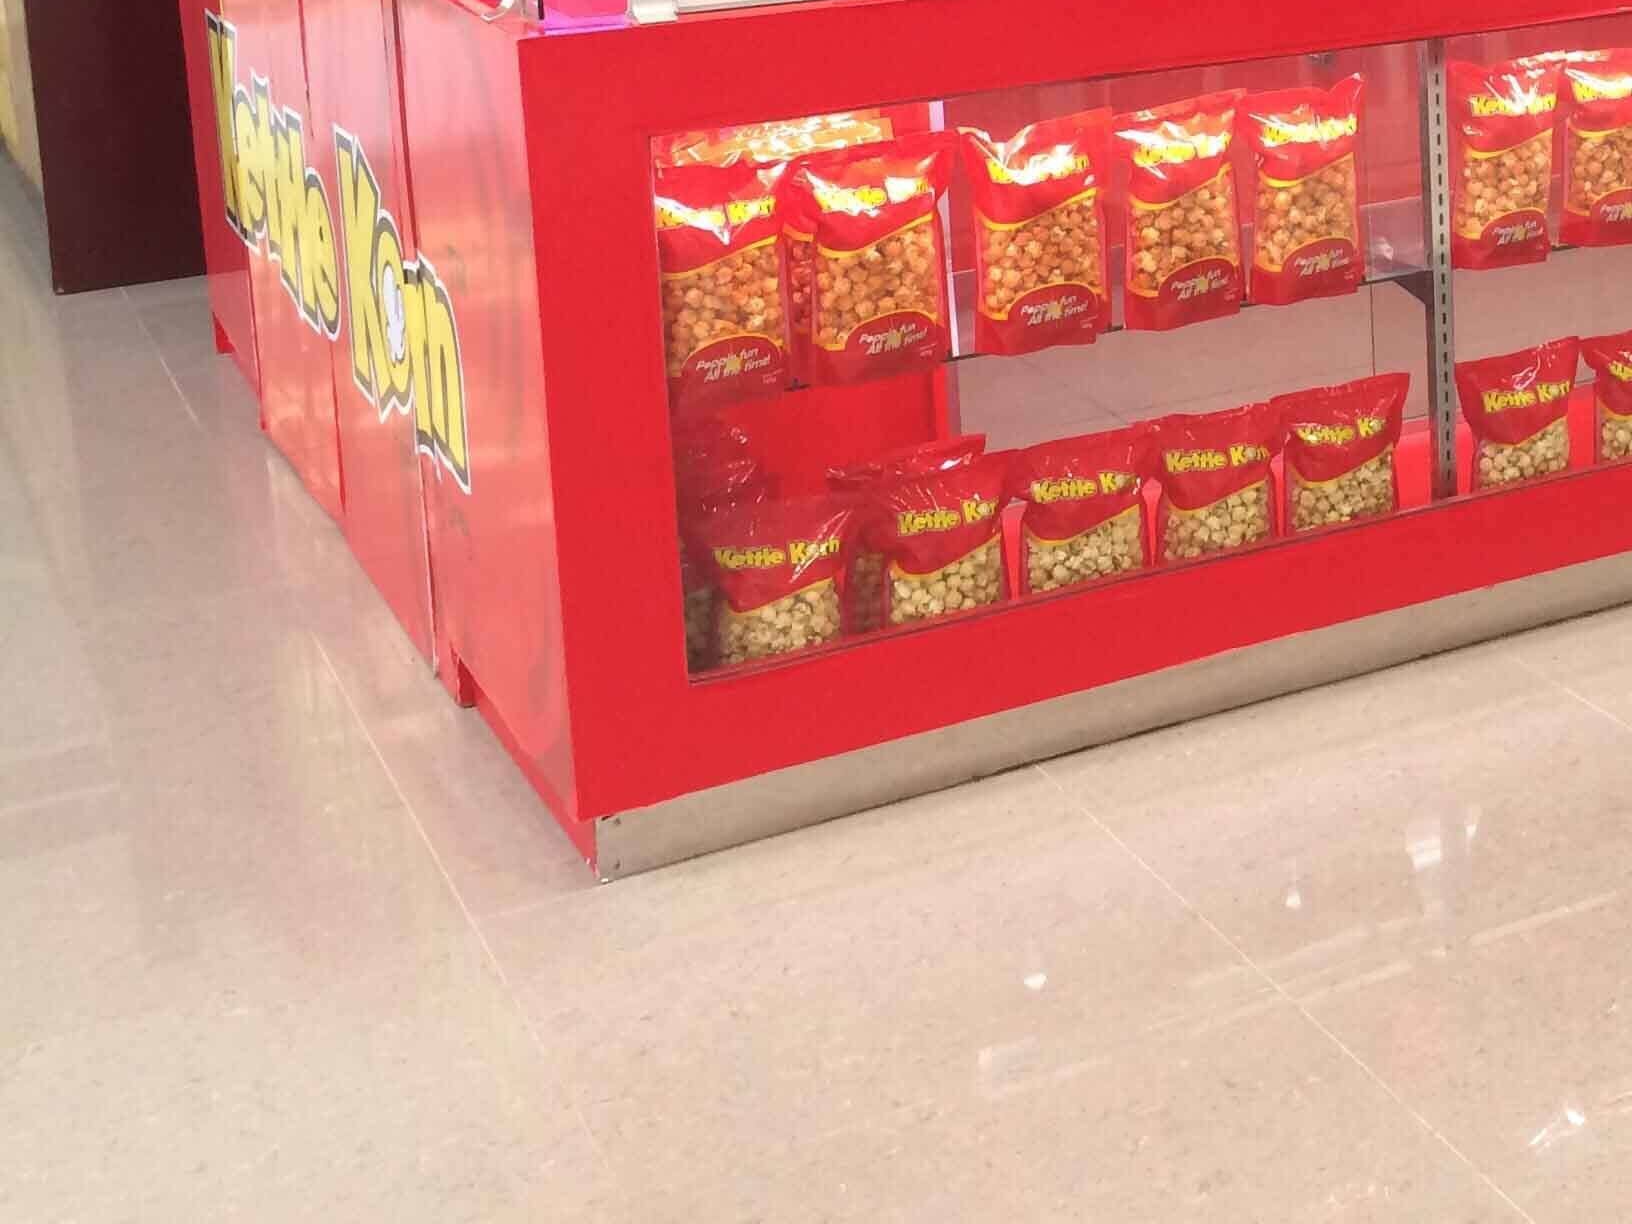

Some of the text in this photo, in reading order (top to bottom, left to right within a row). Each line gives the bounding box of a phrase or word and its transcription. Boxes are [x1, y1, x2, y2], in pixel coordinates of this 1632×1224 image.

[204, 7, 472, 495] Kettle Korn
[899, 322, 917, 337] fun
[739, 347, 760, 364] fun
[866, 343, 883, 356] All
[705, 367, 722, 383] All
[744, 355, 771, 373] time!
[1483, 389, 1536, 414] Kettle
[1165, 450, 1227, 475] Kettle
[1031, 478, 1098, 504] Kettle
[896, 508, 960, 536] Kettle
[713, 538, 841, 569] Kettle Korn
